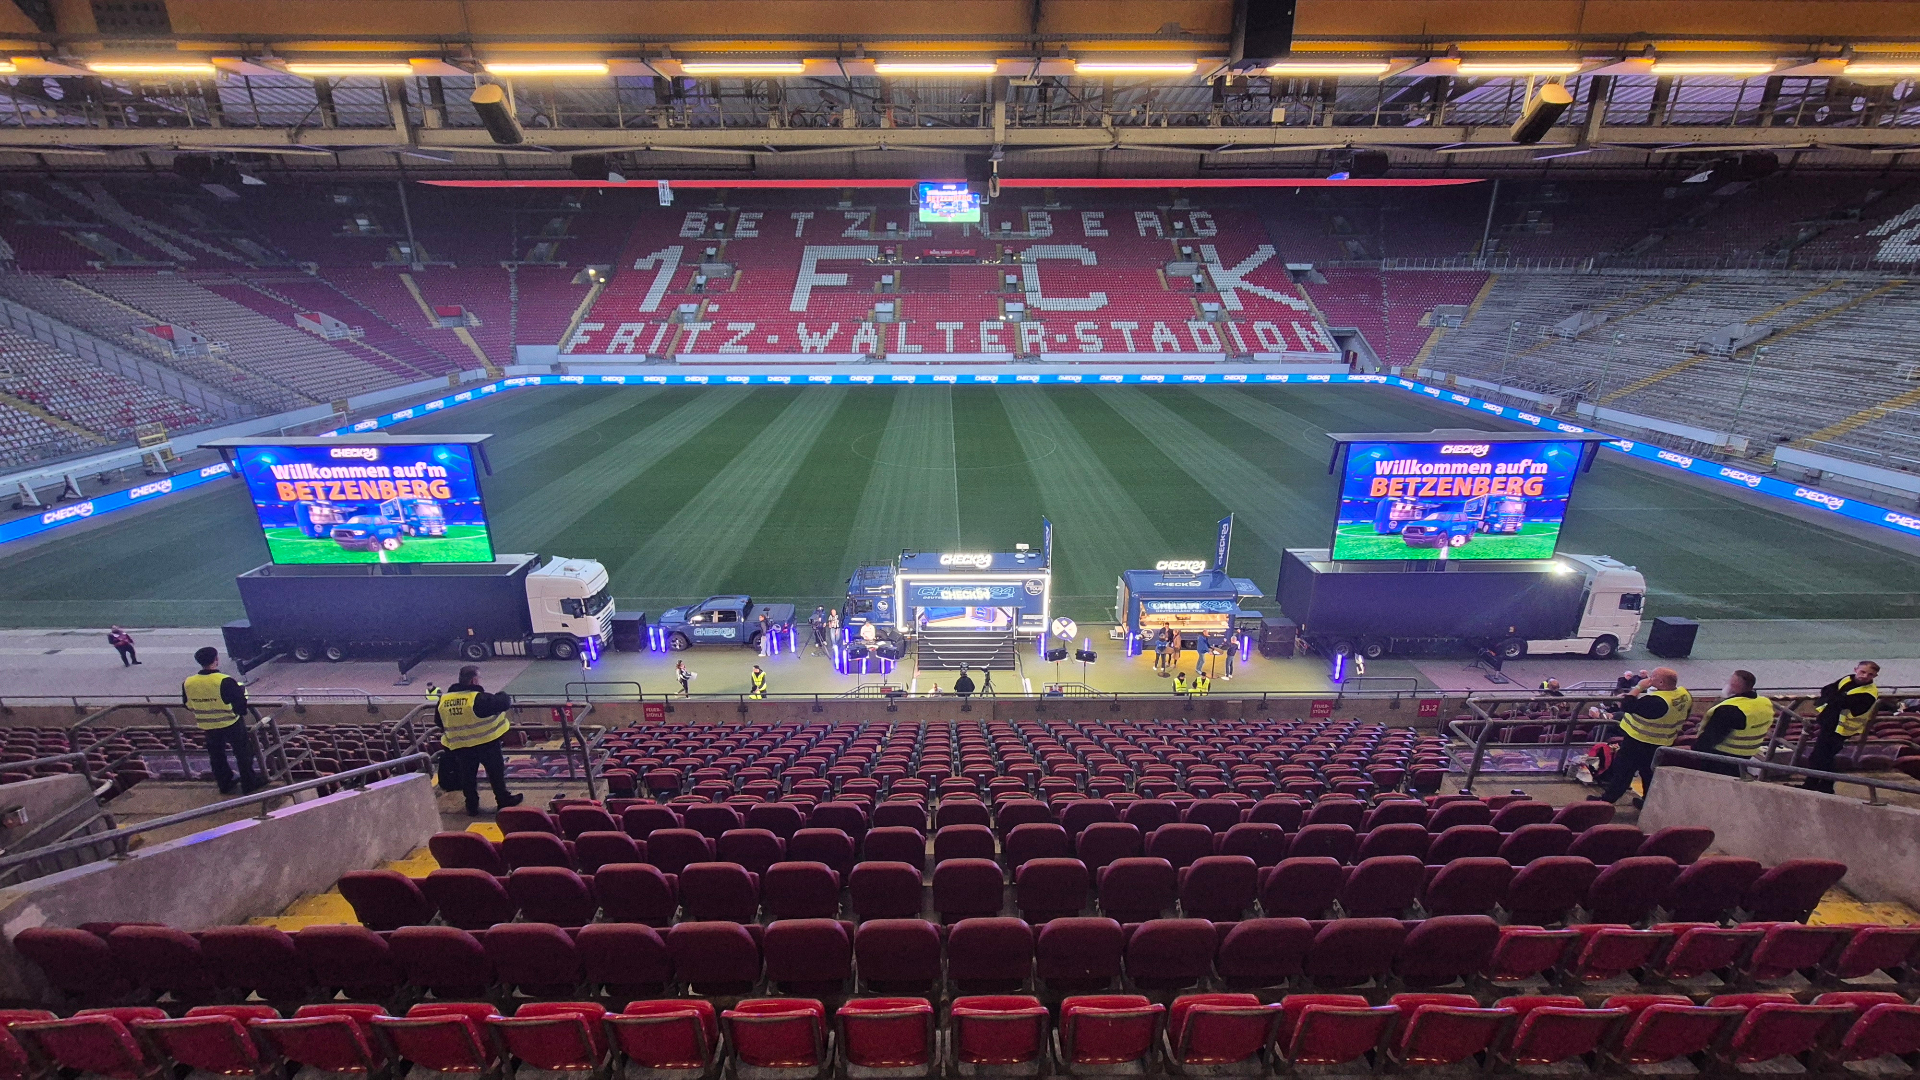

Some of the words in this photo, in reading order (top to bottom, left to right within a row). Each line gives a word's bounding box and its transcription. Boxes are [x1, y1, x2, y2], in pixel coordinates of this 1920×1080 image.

[330, 448, 378, 461] CHECK24
[1440, 444, 1490, 457] CHECK24
[1658, 450, 1692, 468] CHECK24
[270, 463, 390, 480] Willkommen
[393, 462, 448, 478] auf'm
[1375, 459, 1492, 476] Willkommen
[1495, 458, 1548, 474] auf'm
[1720, 467, 1761, 487] CHECK24
[130, 479, 172, 499] CHECK24
[276, 479, 451, 502] BETZENBERG
[1370, 476, 1544, 497] BETZENBERG
[1795, 487, 1844, 510] CHECK24
[43, 502, 94, 524] CHECK24
[1218, 523, 1228, 566] CHECK24
[940, 554, 992, 568] CHECK24
[1156, 560, 1206, 574] CHECK24
[694, 627, 736, 638] CHECK24
[444, 697, 468, 708] SECURITY
[448, 707, 464, 716] 1332
